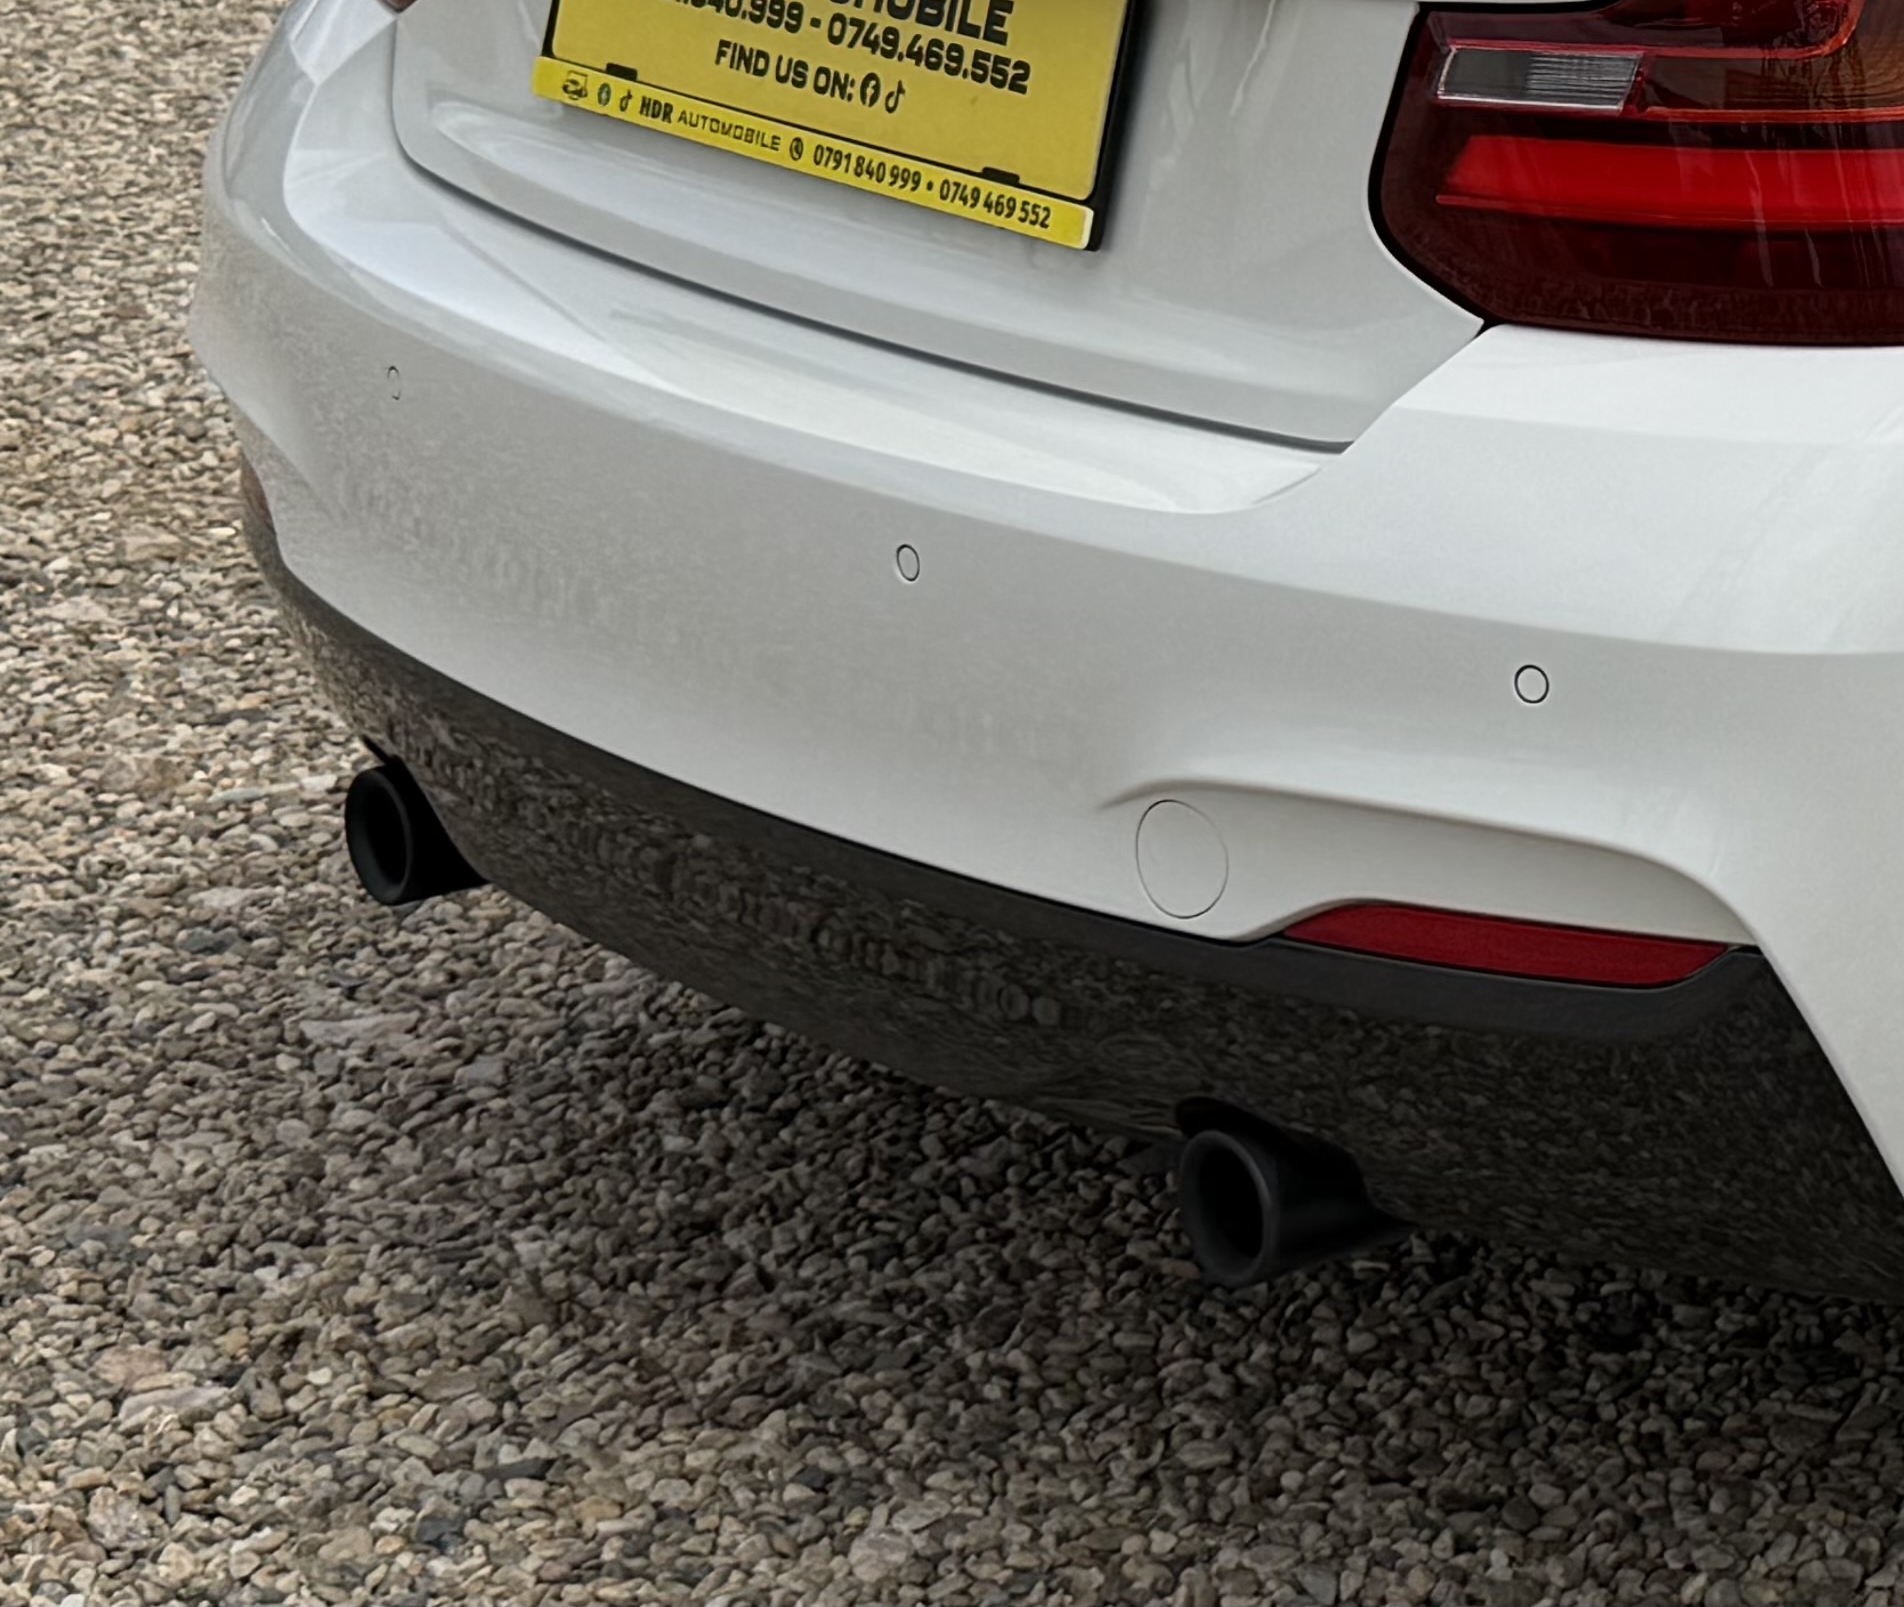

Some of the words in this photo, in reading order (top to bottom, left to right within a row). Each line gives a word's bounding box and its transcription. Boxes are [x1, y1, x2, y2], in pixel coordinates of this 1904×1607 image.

[715, 39, 770, 78] FIND
[775, 54, 809, 89] US
[813, 65, 857, 103] ON:
[827, 12, 1031, 95] 0749.469.552
[639, 95, 674, 125] HDR
[677, 109, 782, 152] AUTOMOBILE
[813, 143, 852, 174] 0791
[854, 155, 887, 184] 840
[889, 170, 922, 192] 999
[939, 179, 982, 210] 0749
[983, 190, 1017, 220] 469
[1017, 201, 1052, 230] 552
